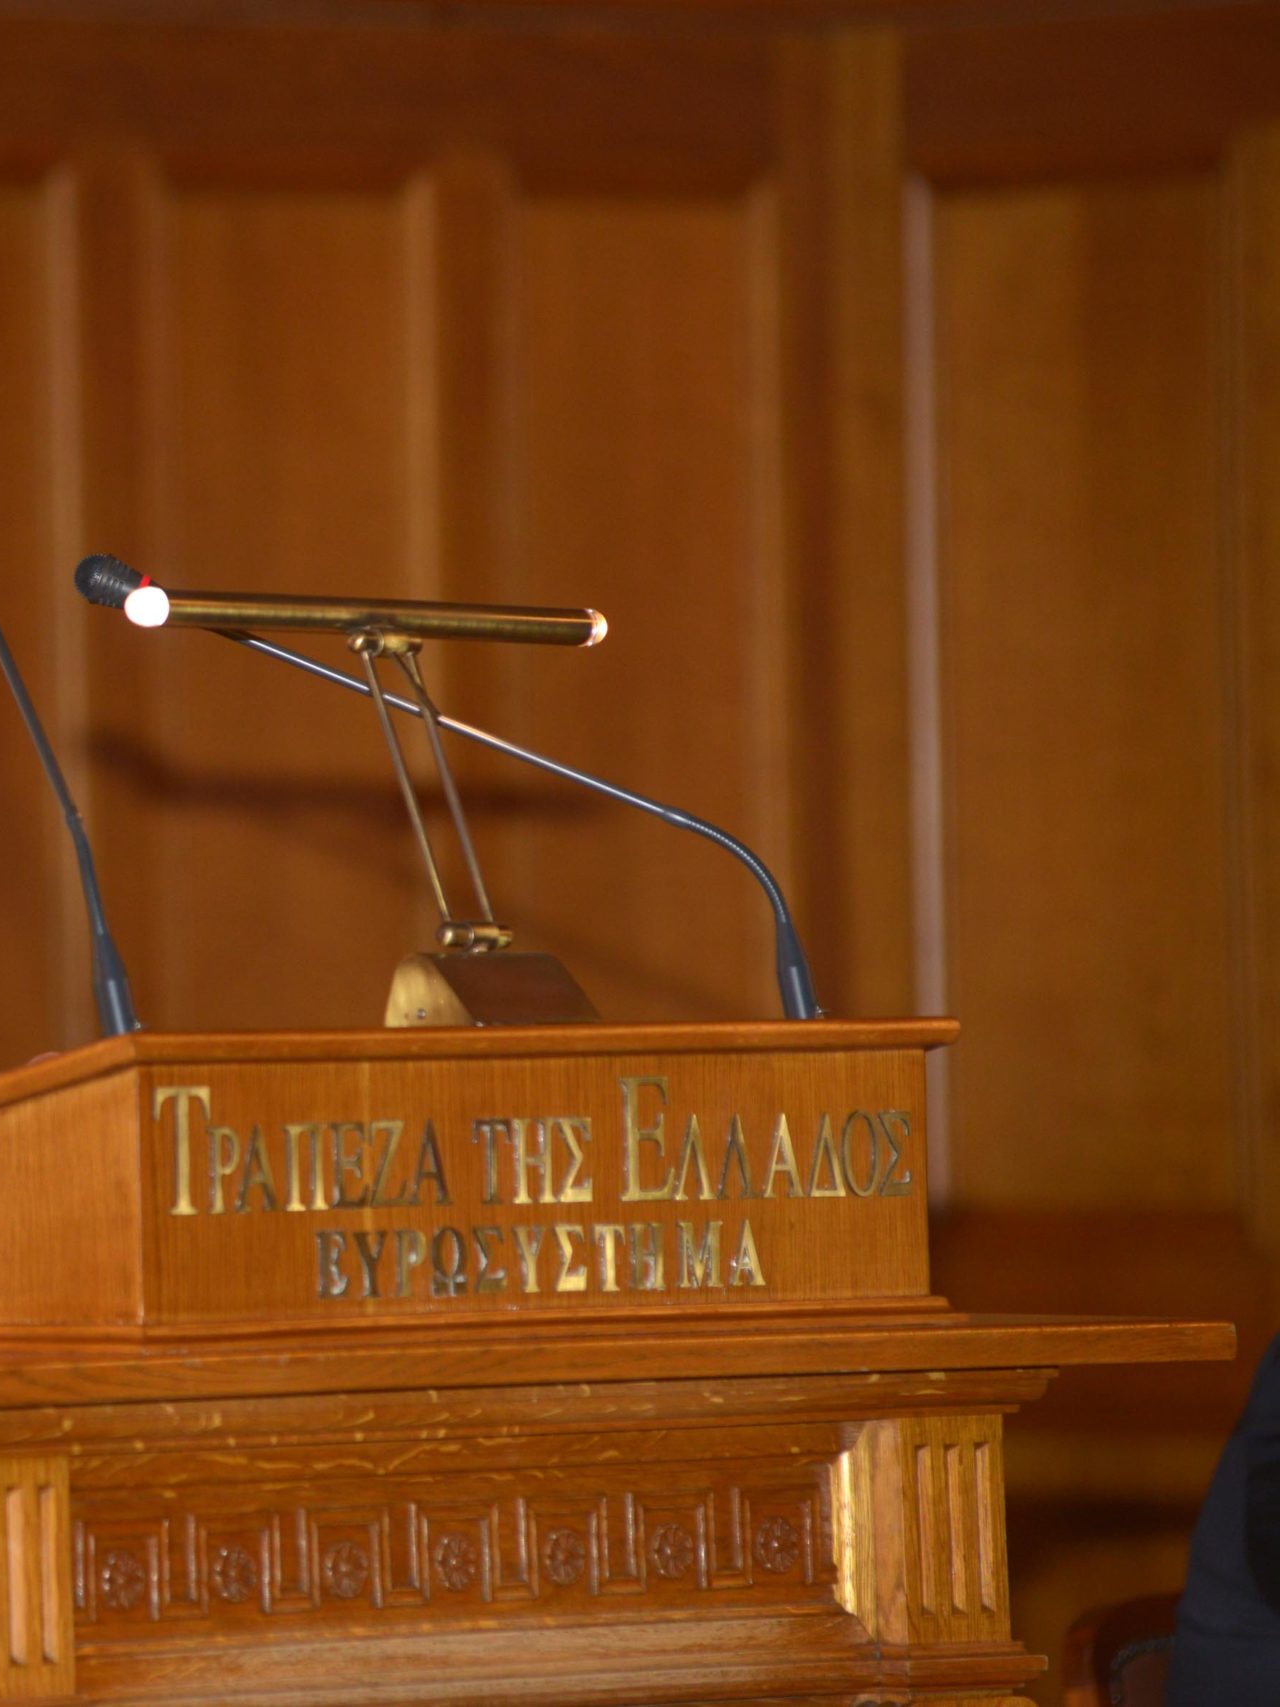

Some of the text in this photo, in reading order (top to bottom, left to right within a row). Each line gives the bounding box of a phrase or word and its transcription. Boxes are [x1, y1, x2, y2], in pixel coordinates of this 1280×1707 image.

[154, 1076, 913, 1214] ΤΡΑΠΕΖΑ ΤΗΣ ΕΛΛΑΔΟΣ
[315, 1218, 767, 1298] ΕΥΡΩΣΥΣΤΗΜΑ
